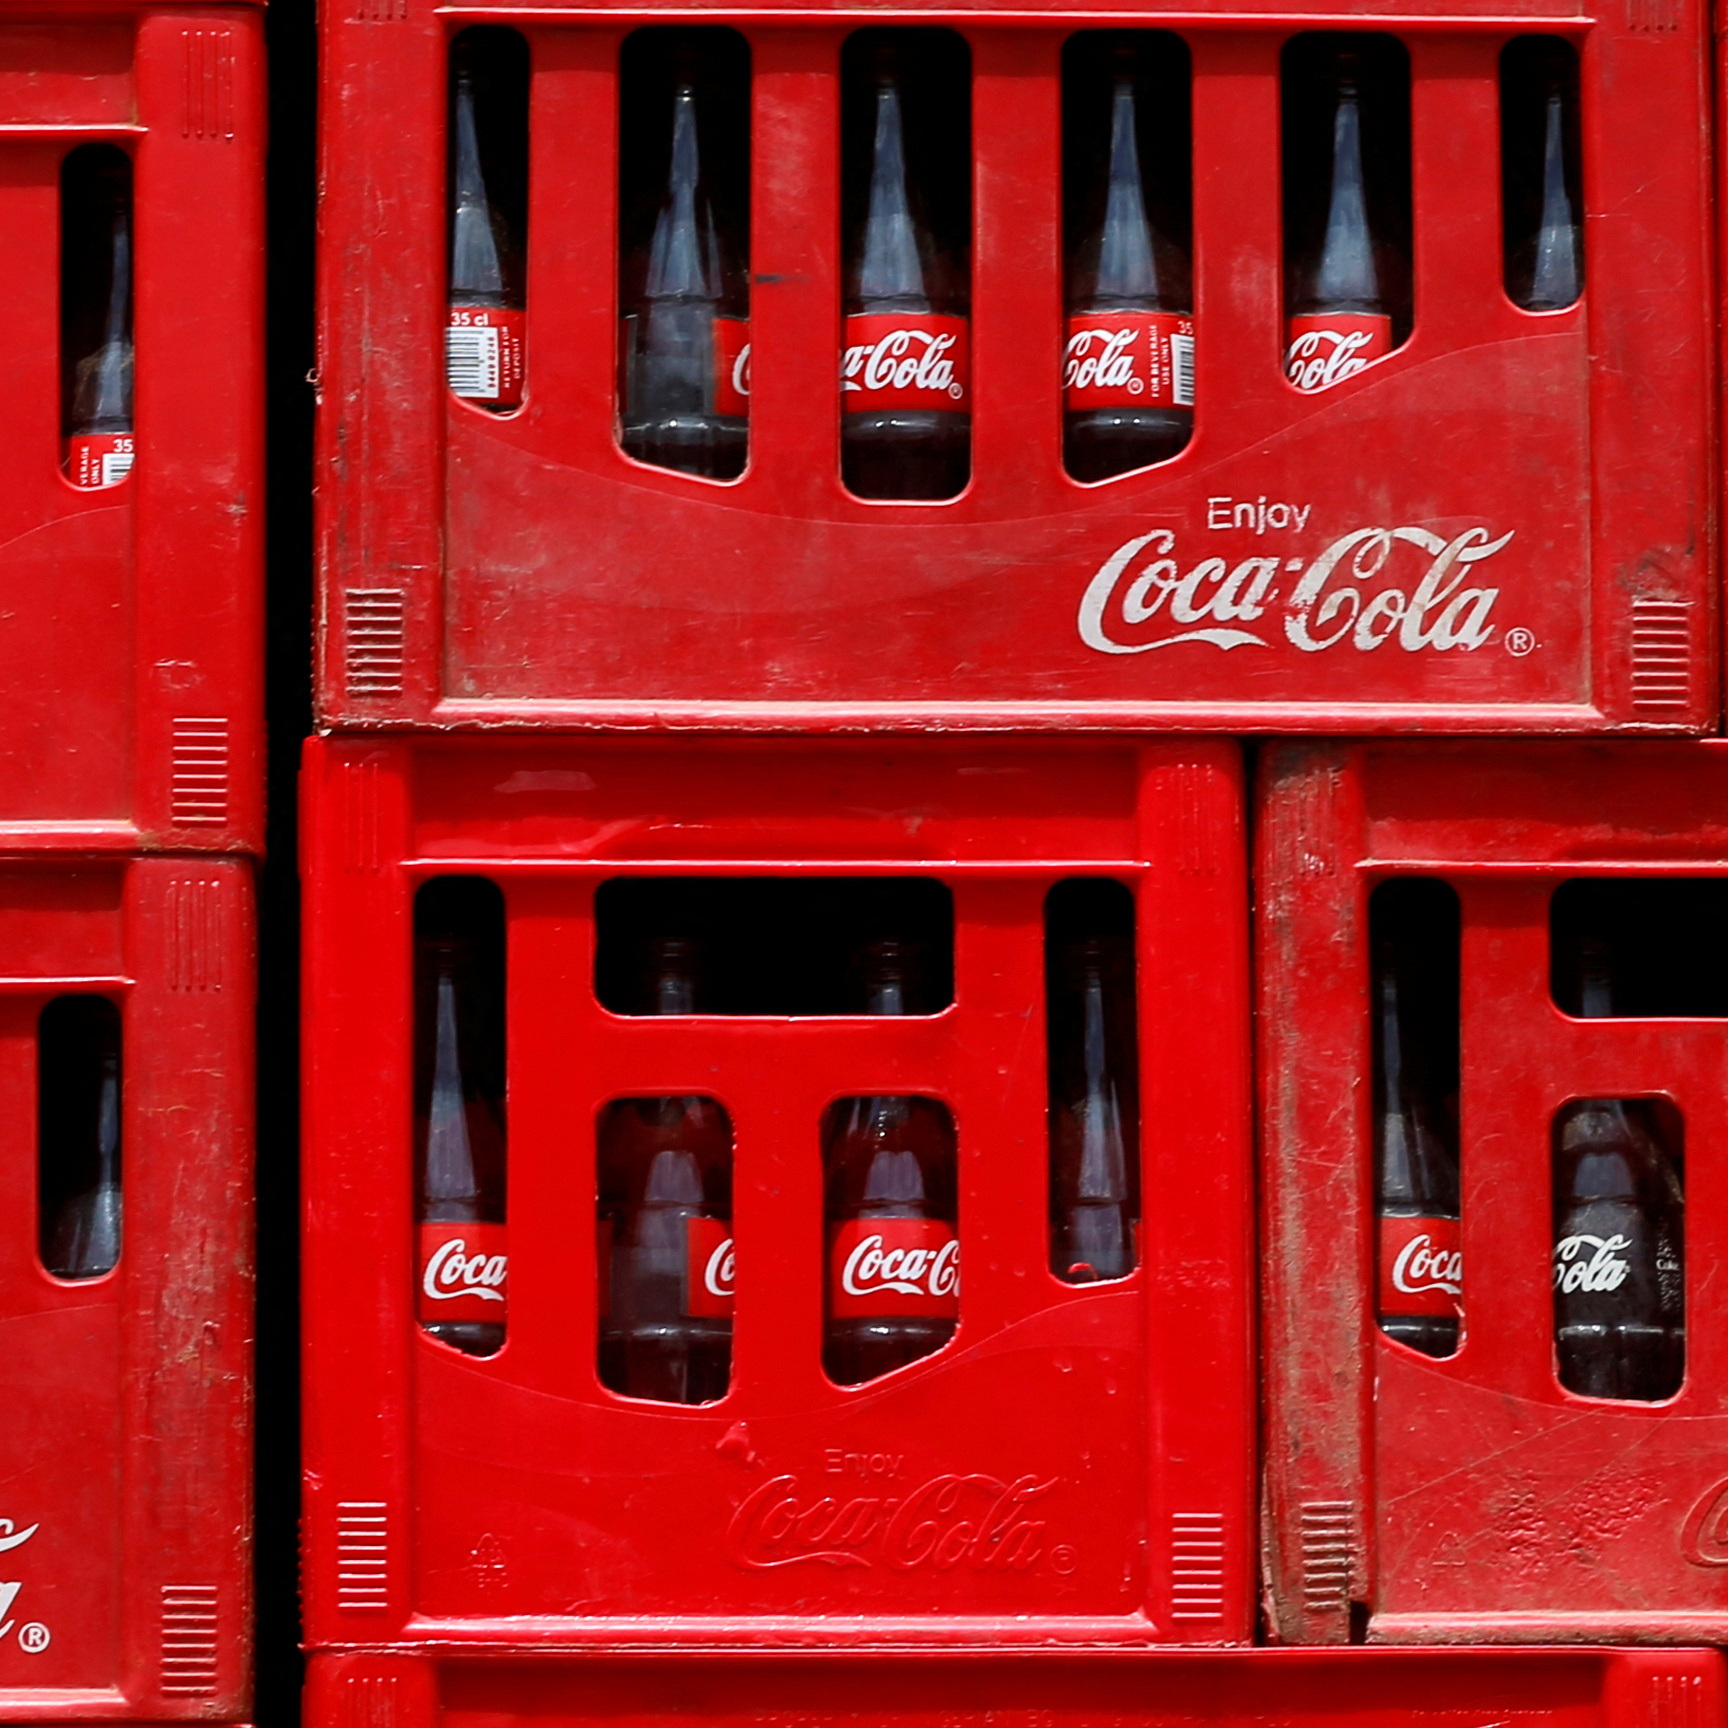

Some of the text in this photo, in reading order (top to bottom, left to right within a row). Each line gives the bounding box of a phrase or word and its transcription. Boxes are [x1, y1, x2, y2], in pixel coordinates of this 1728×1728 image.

[450, 312, 489, 326] 35 cl
[500, 325, 512, 389] RETURN FOR
[1149, 325, 1160, 397] FOR BEVERAGE
[1161, 337, 1170, 386] USE ONLY
[112, 439, 133, 453] 35
[1207, 495, 1311, 533] Enjoy
[1077, 525, 1516, 655] Coca-Cola
[728, 1473, 1060, 1571] Coca-Cola
